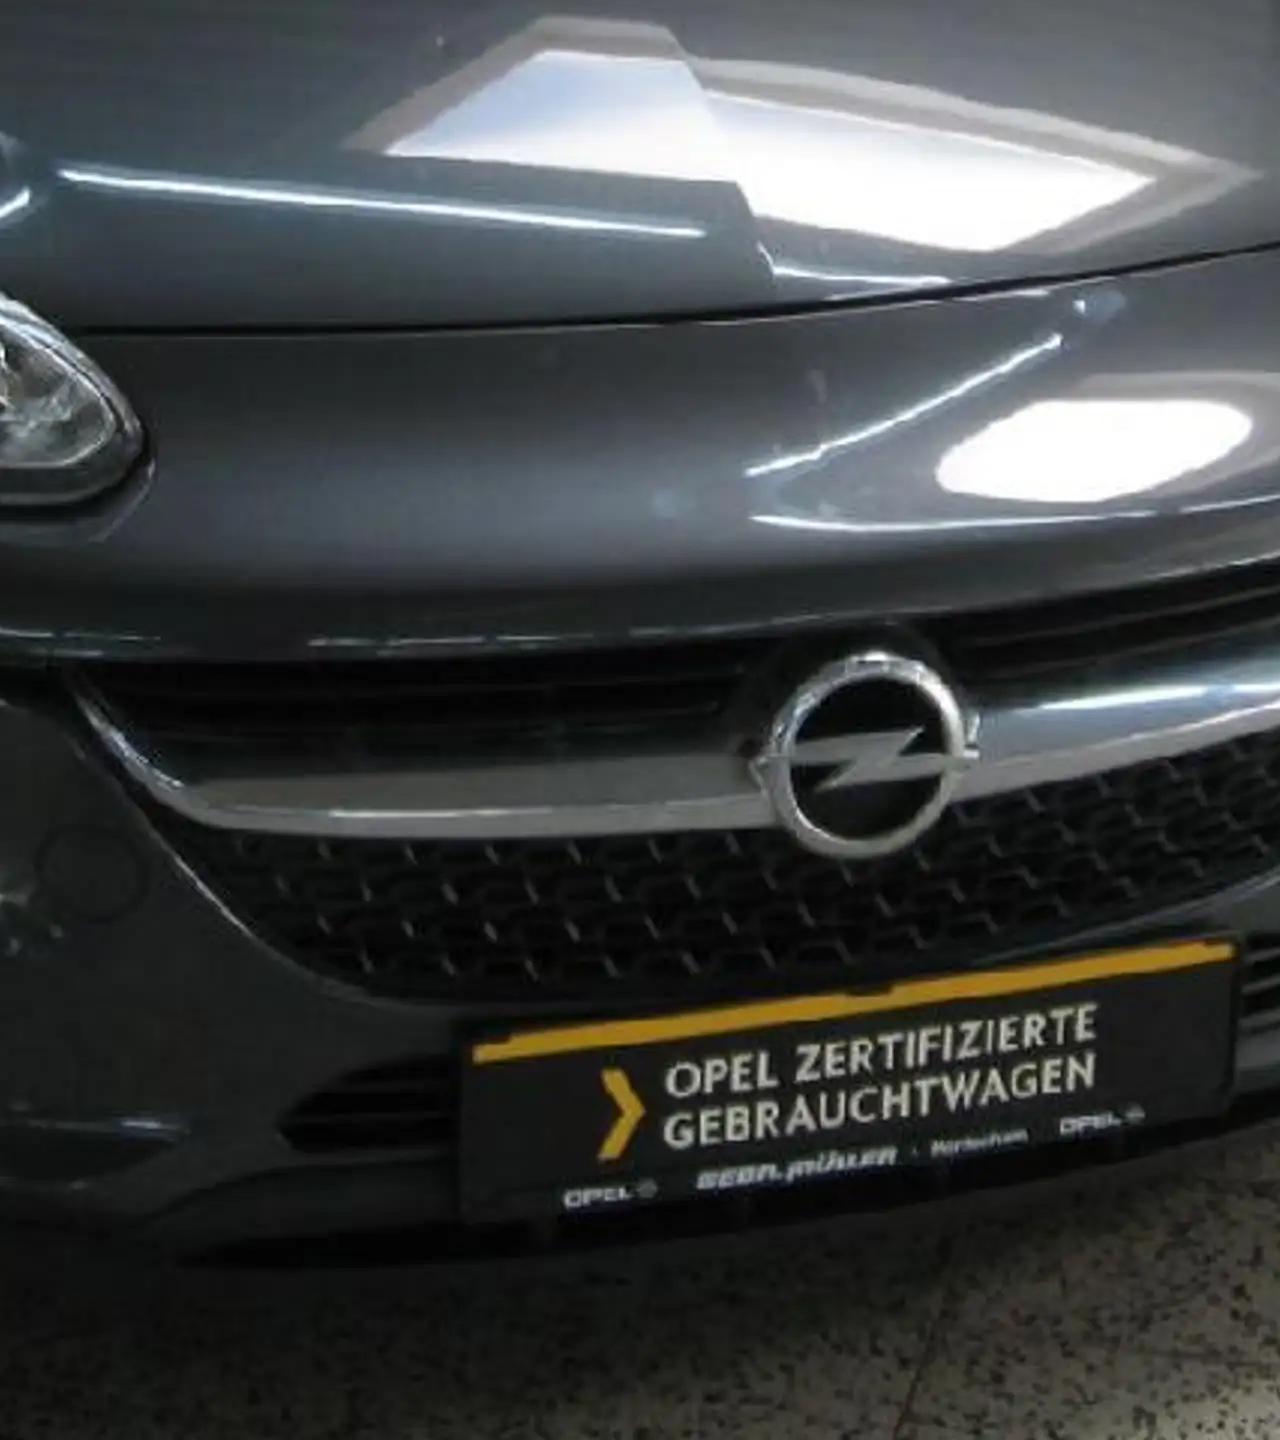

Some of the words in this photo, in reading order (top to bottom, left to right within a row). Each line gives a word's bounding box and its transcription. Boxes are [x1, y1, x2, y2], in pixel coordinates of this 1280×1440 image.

[665, 1051, 779, 1098] OPEL
[795, 1002, 1098, 1083] ZERTIFIZIERTE
[663, 1053, 1097, 1150] GEBRAUCHTWAGEN
